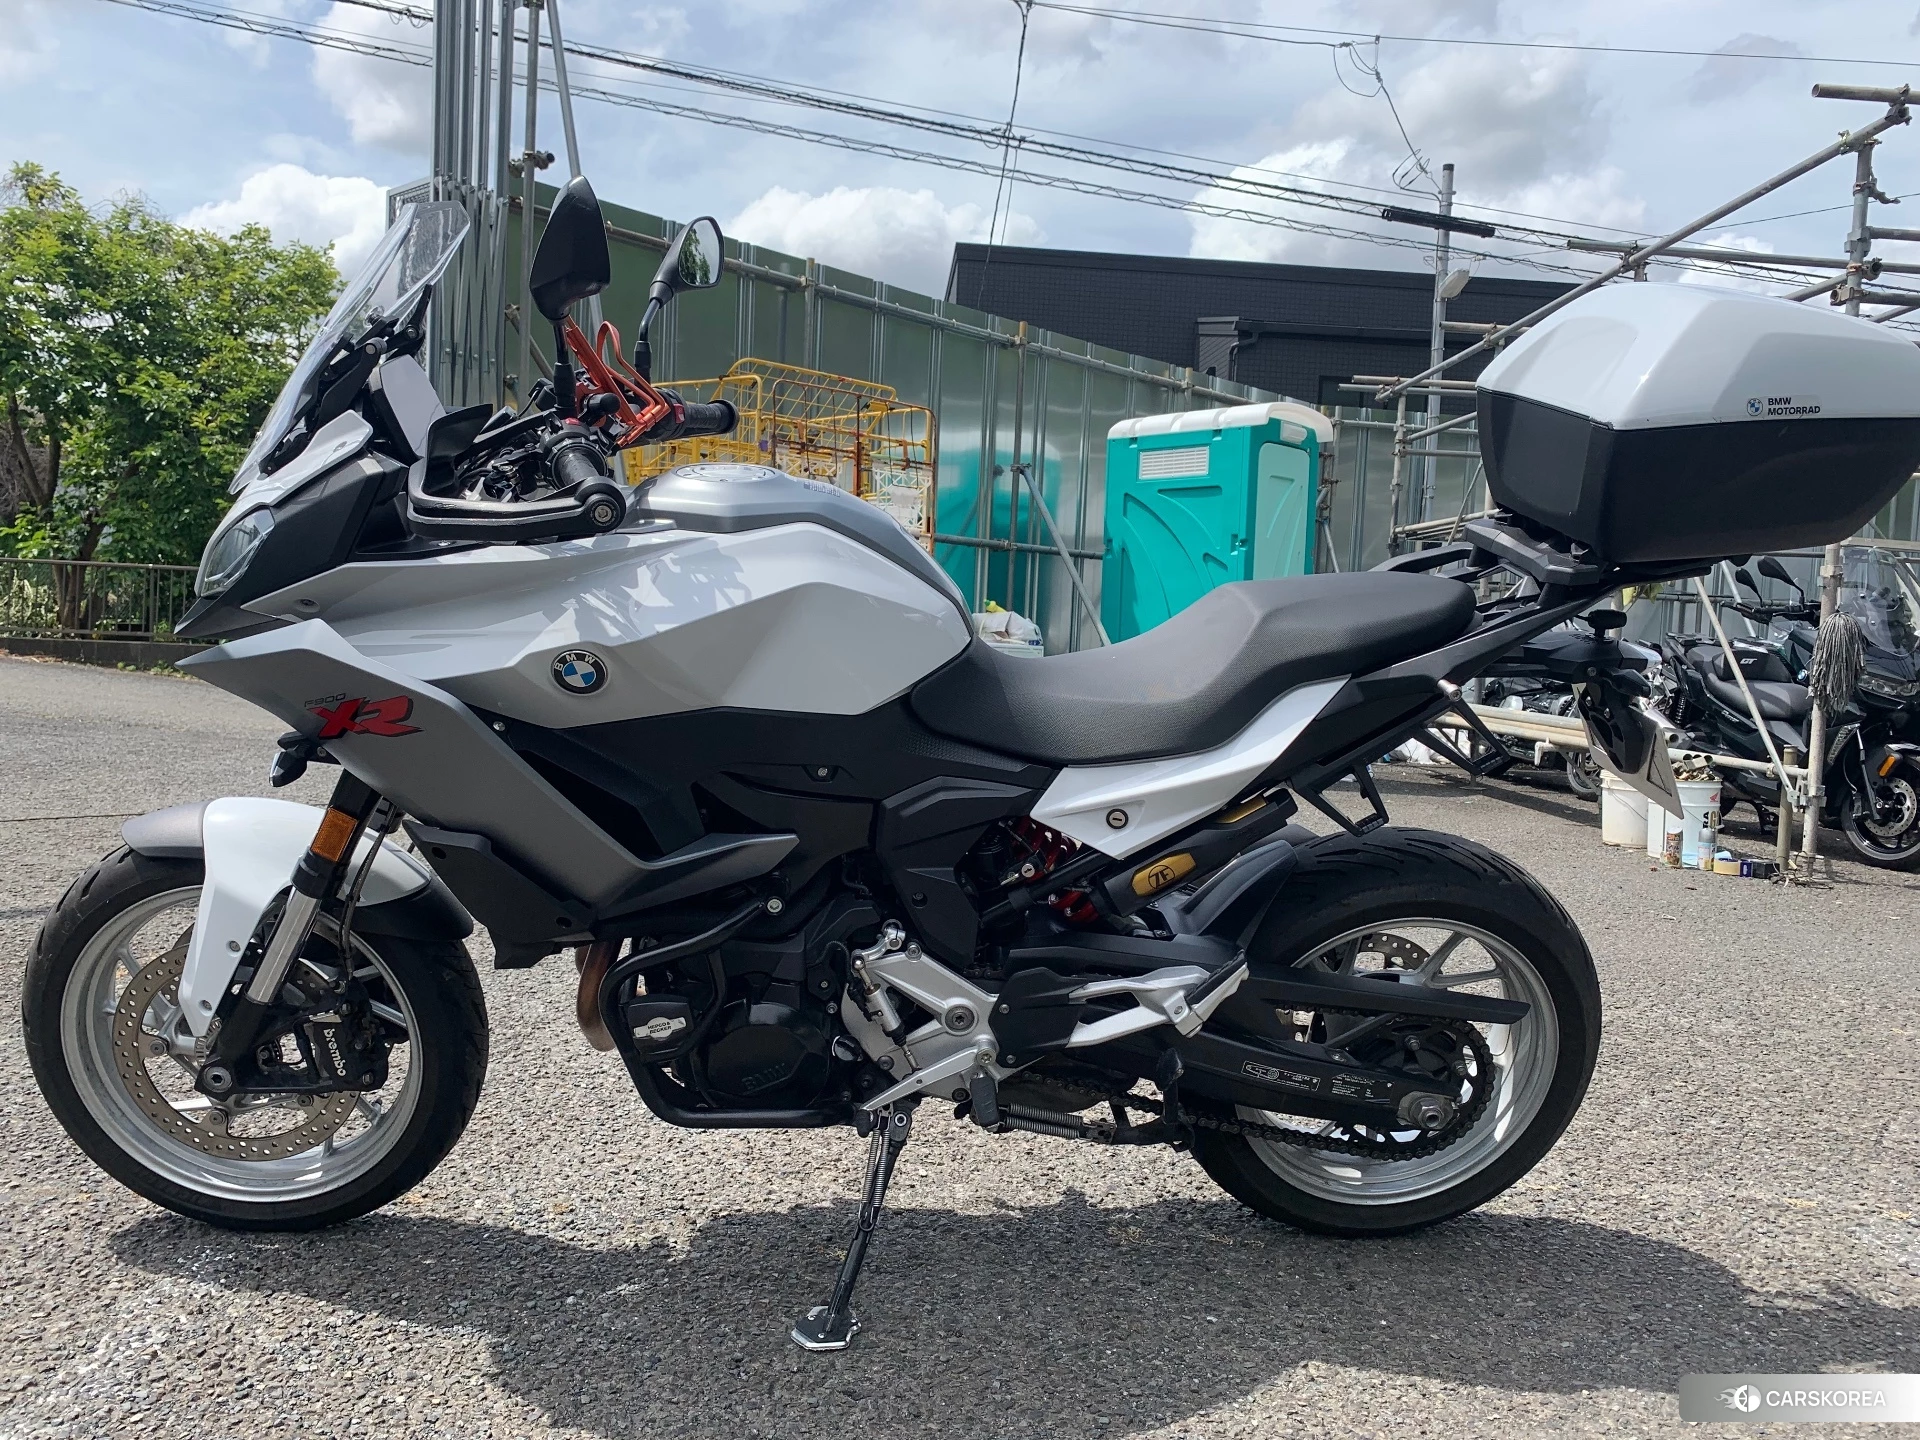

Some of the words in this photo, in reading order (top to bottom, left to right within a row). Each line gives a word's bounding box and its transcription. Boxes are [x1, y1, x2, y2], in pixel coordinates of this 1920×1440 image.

[1767, 397, 1792, 406] BMW
[1767, 406, 1821, 416] MOTORRAD
[304, 693, 346, 707] F900
[306, 695, 424, 739] XR
[1148, 866, 1172, 889] ZF
[323, 1028, 347, 1077] brembo
